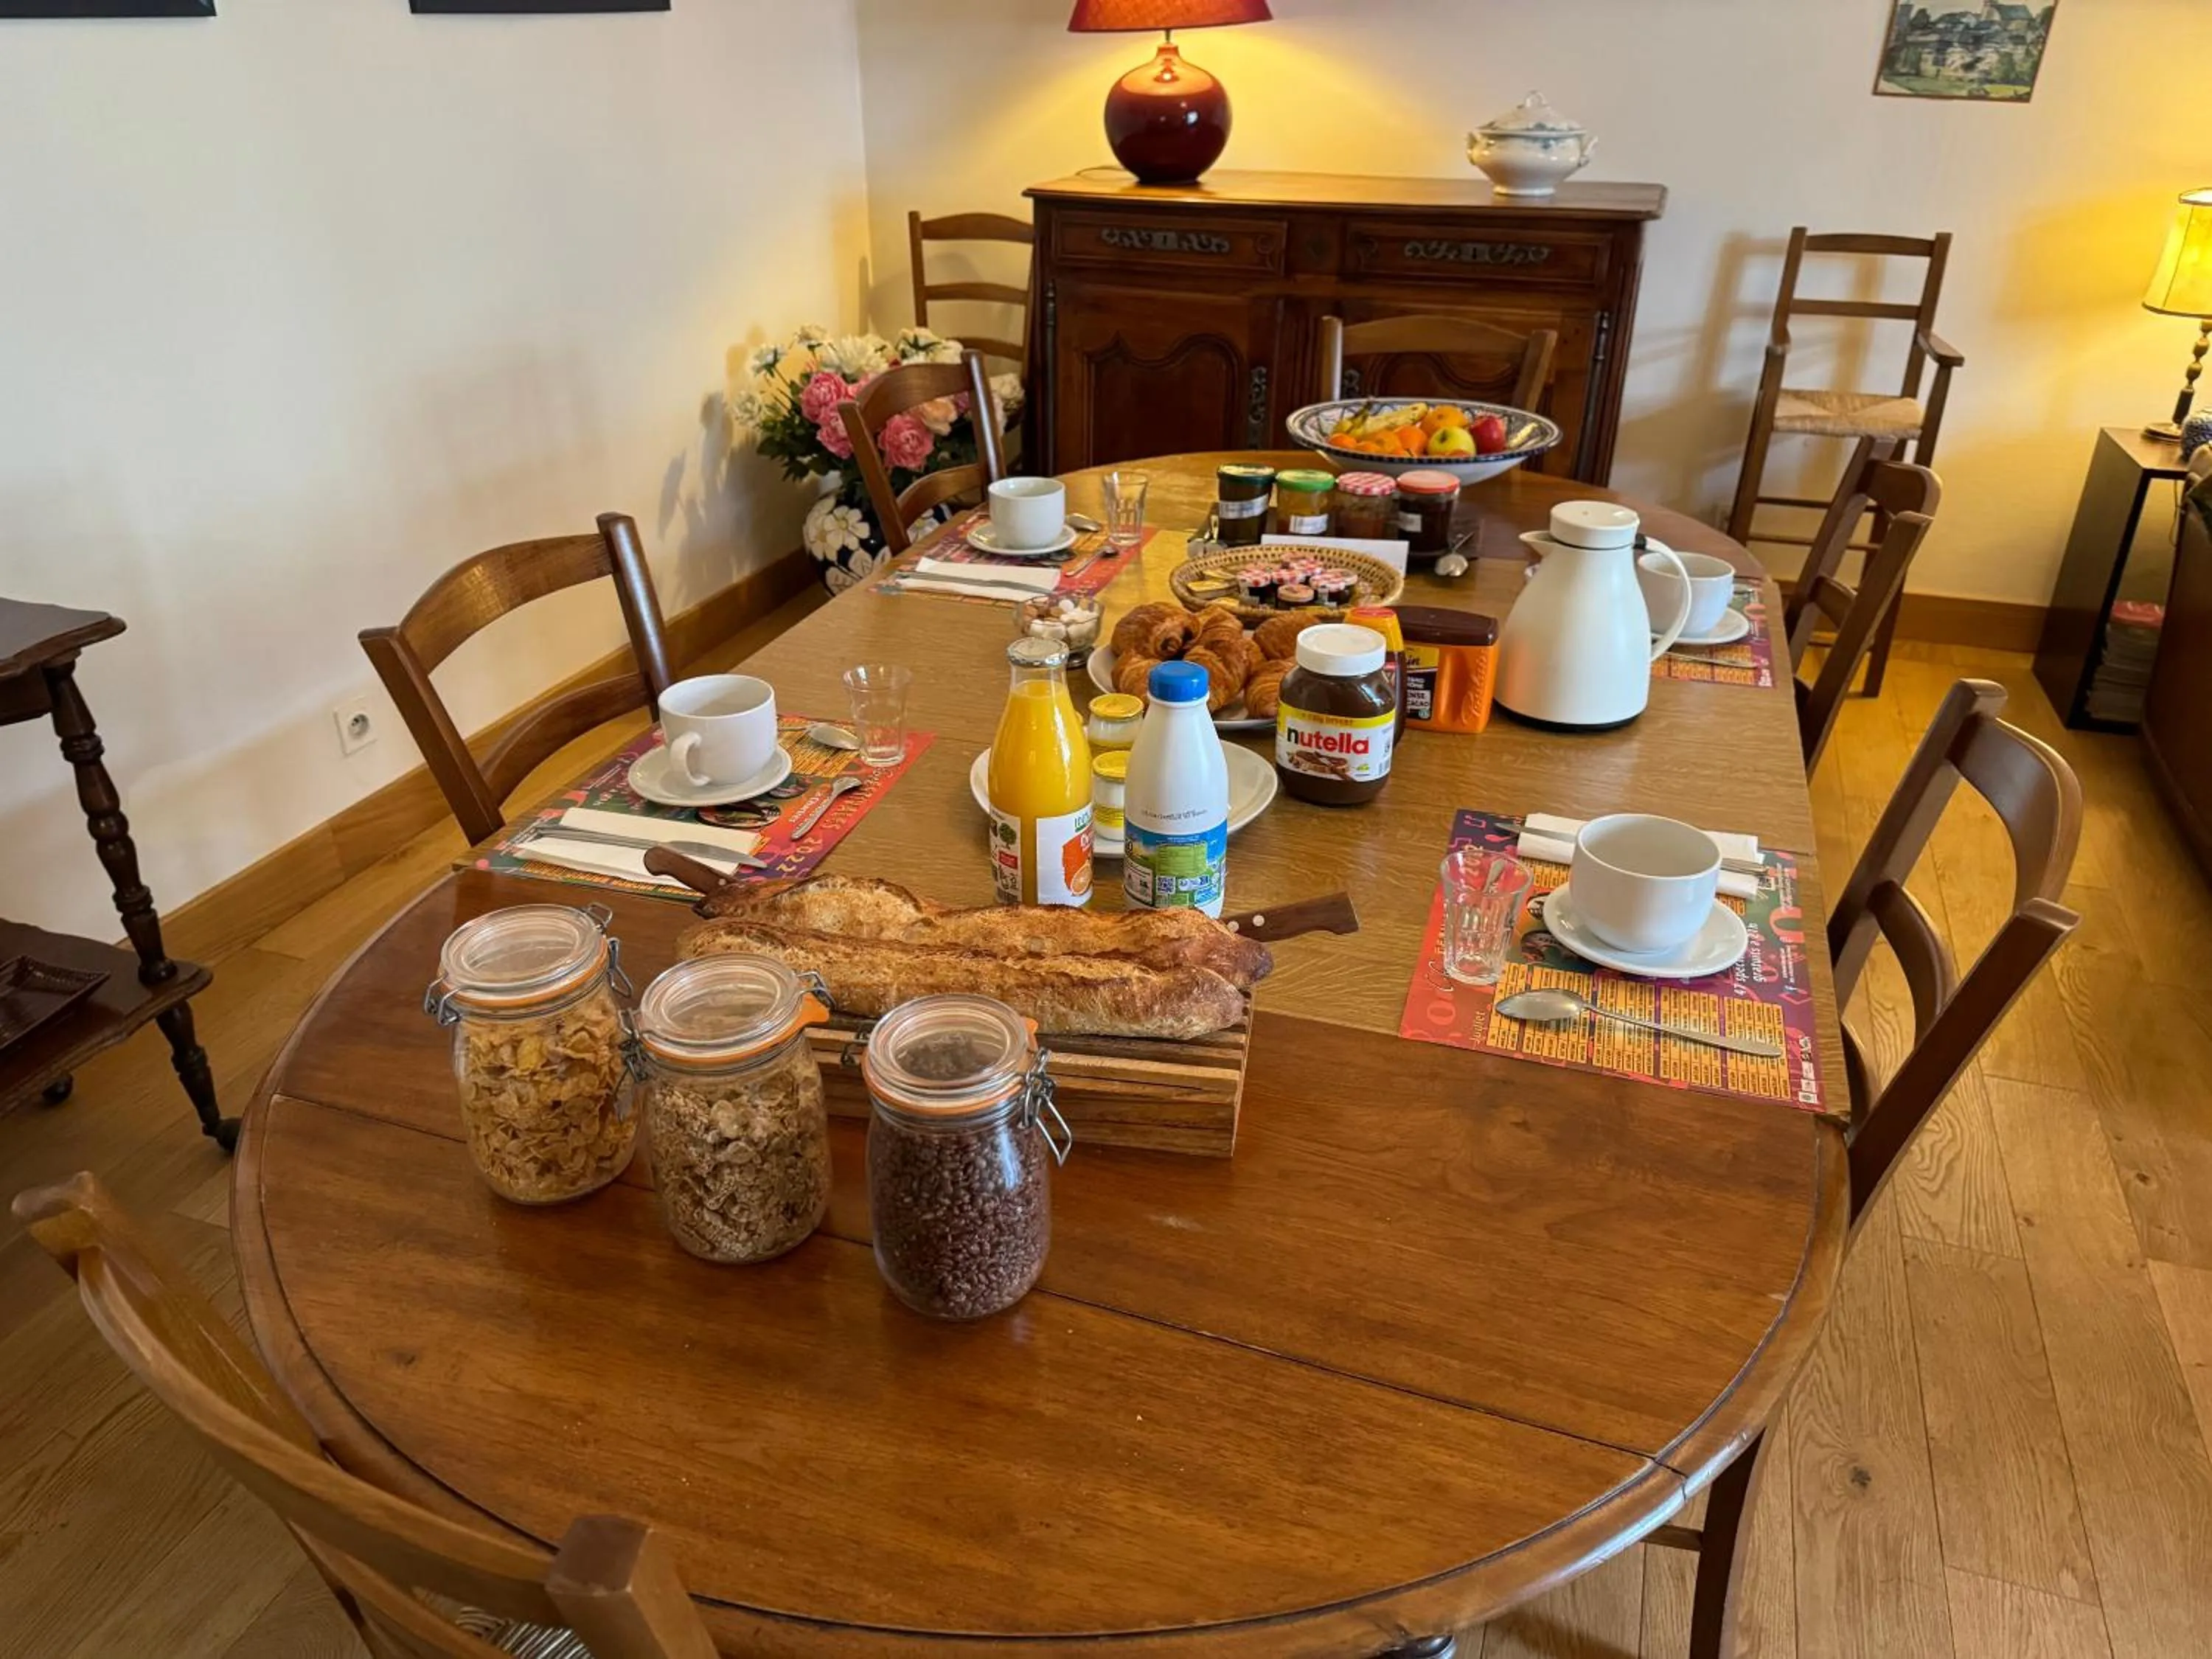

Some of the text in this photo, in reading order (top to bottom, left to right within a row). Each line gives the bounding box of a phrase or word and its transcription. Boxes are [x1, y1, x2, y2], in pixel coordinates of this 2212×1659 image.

[1287, 728, 1369, 754] nutella
[776, 837, 823, 872] 2022
[1750, 947, 1767, 982] gratuits
[1733, 984, 1747, 995] 47
